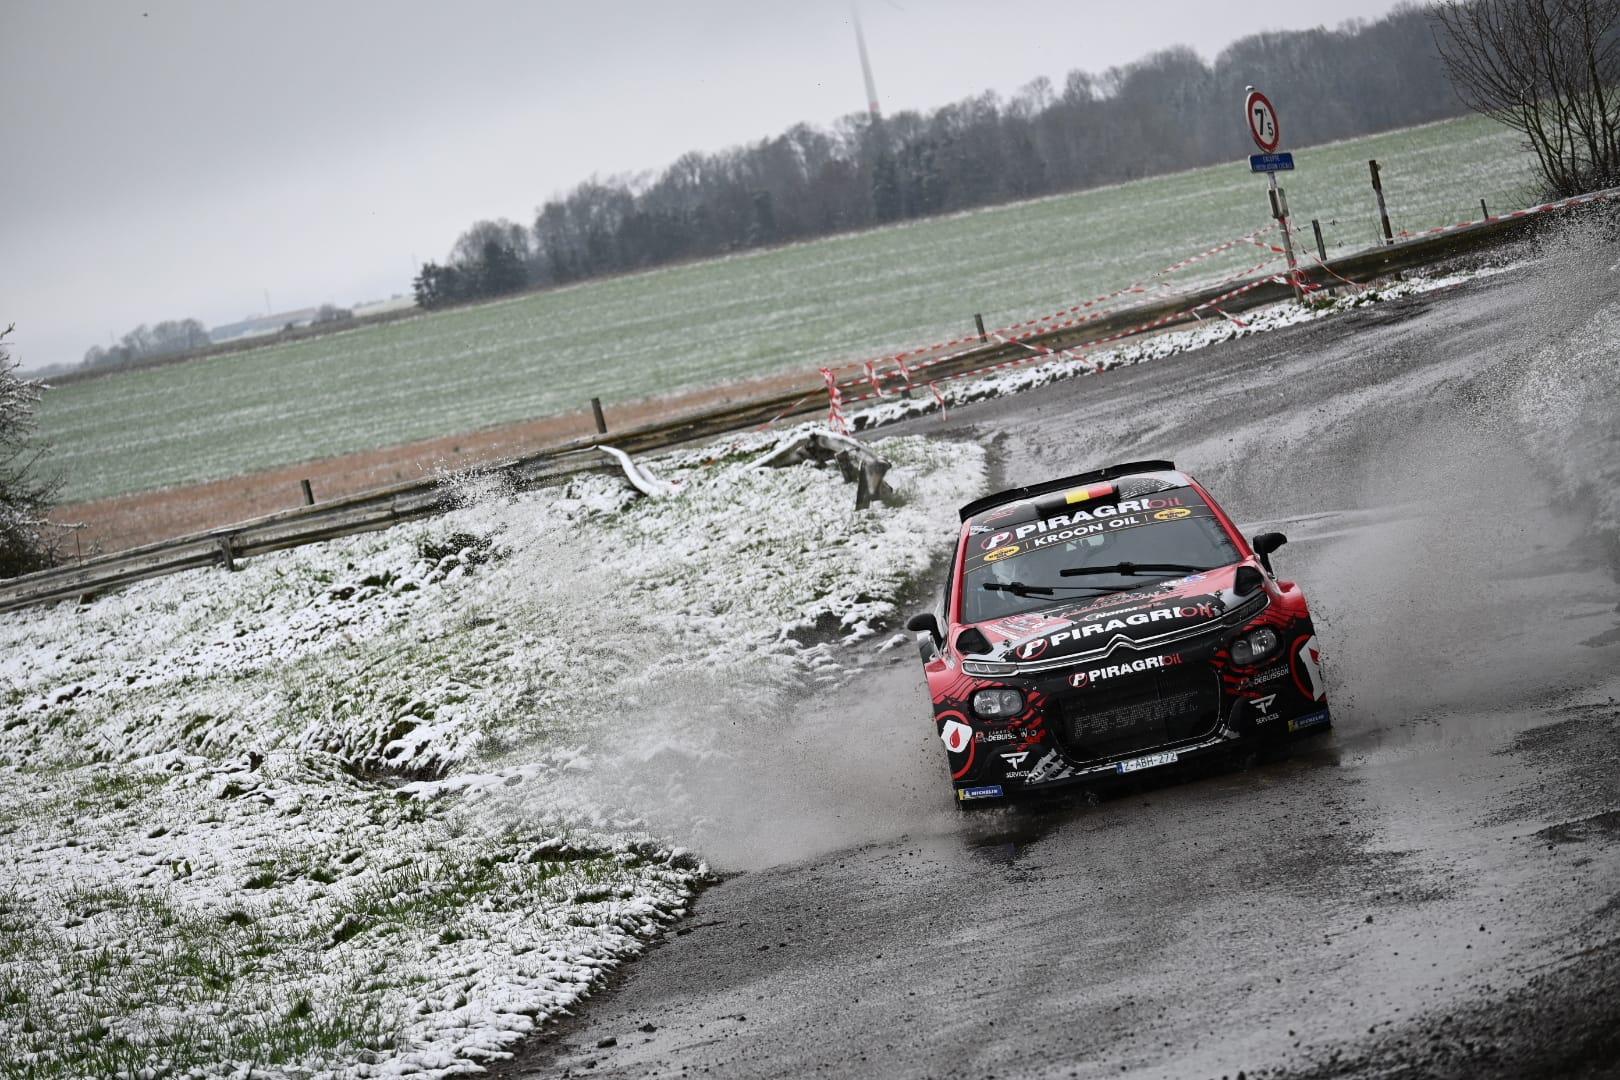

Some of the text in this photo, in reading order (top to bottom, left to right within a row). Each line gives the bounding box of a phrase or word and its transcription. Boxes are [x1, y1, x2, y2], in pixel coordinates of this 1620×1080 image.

[1034, 516, 1140, 547] KROON OIL
[1256, 712, 1279, 725] SERVICES
[1006, 770, 1030, 778] SERVICES
